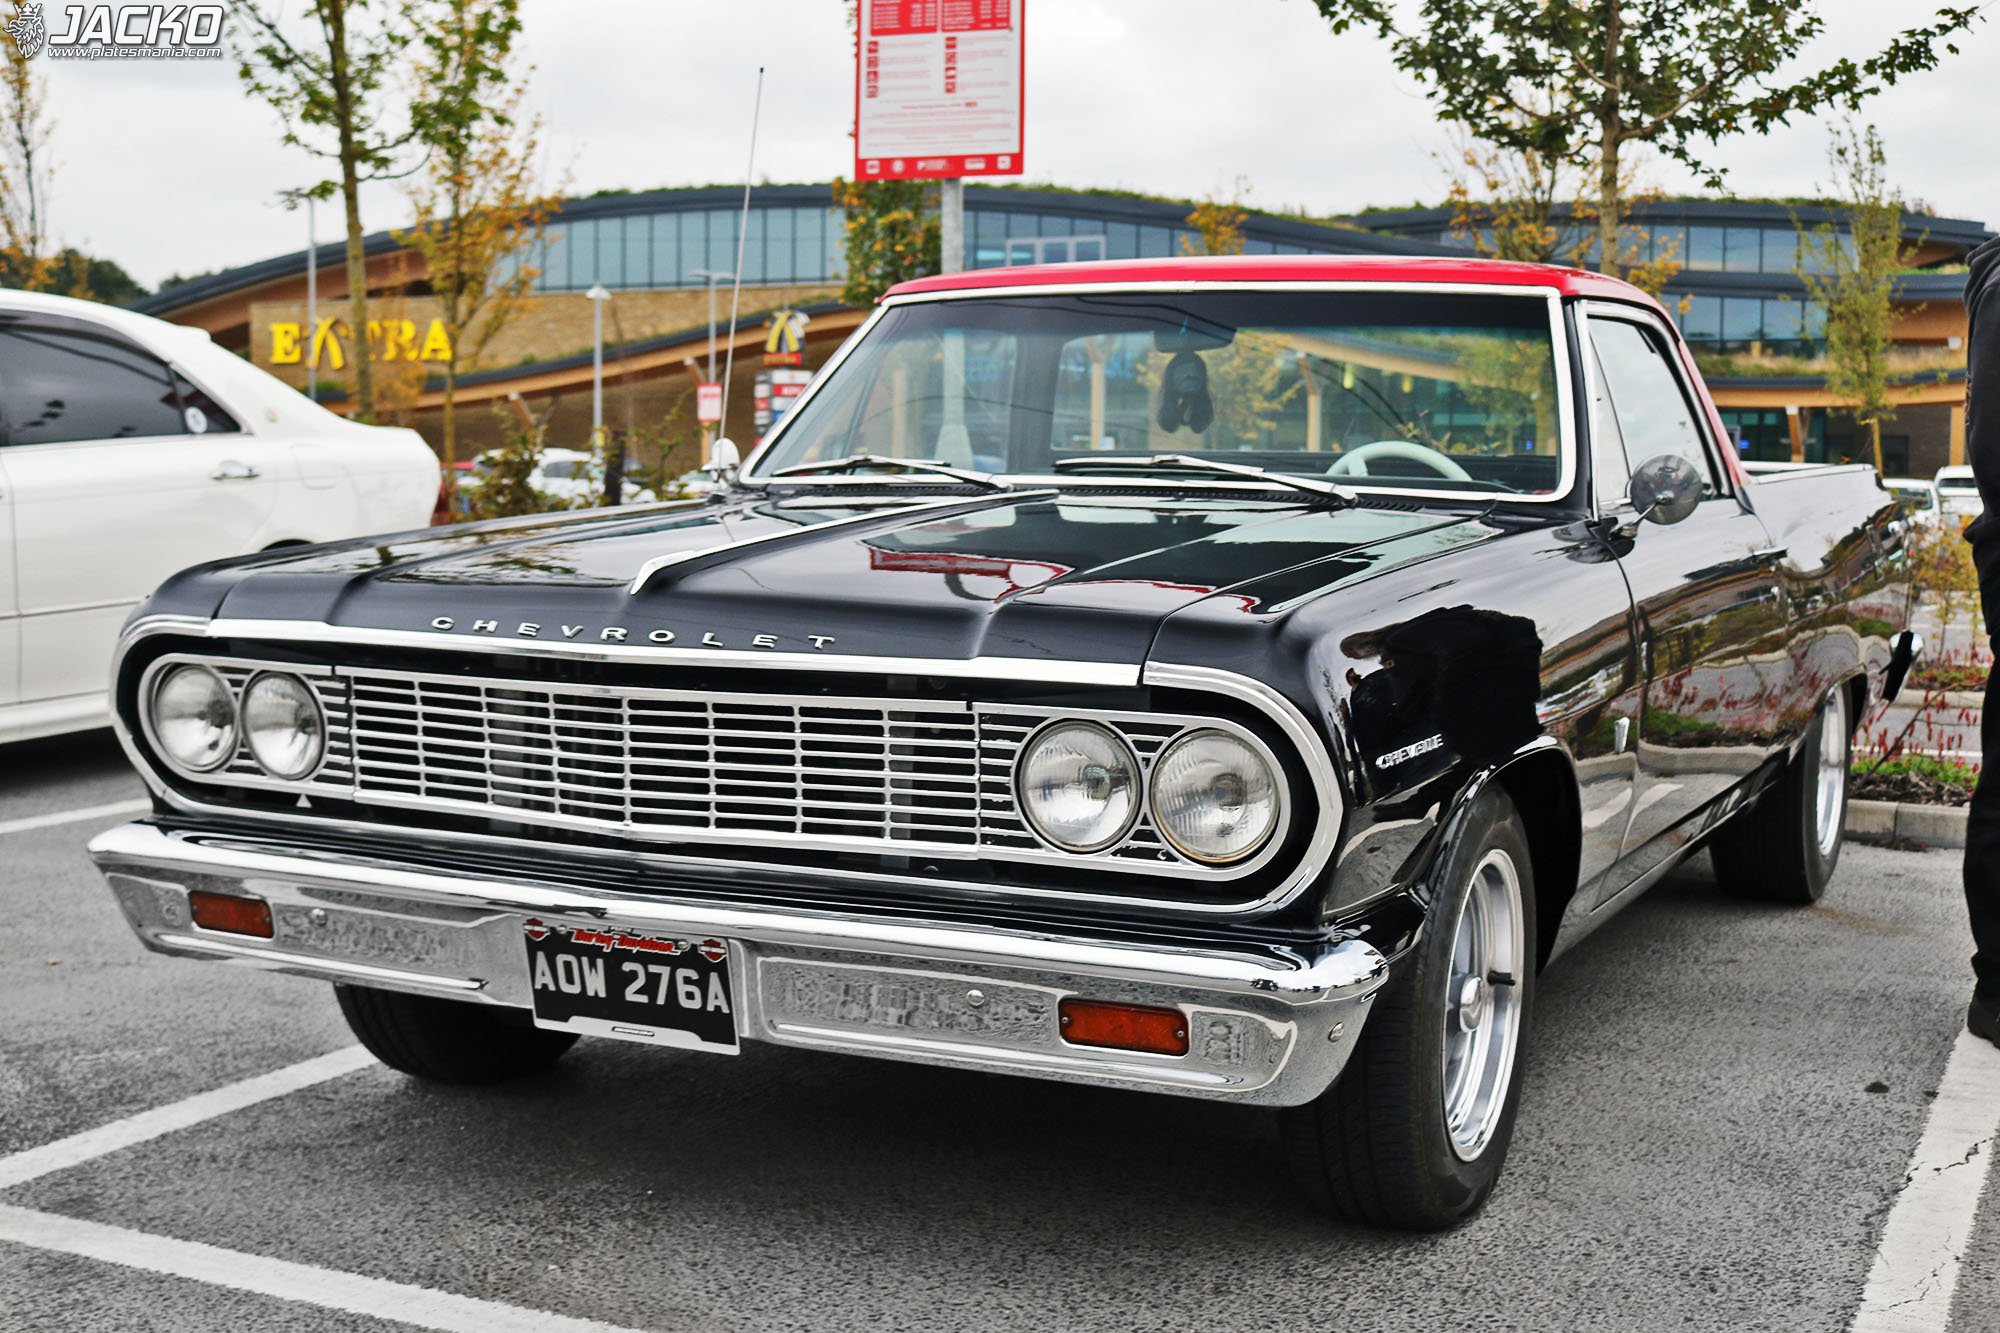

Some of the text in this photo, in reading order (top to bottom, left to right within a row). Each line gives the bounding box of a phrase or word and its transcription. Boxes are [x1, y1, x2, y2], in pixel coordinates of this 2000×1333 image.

[431, 616, 835, 650] CHEVROLET
[534, 951, 730, 1014] AOW 276A
